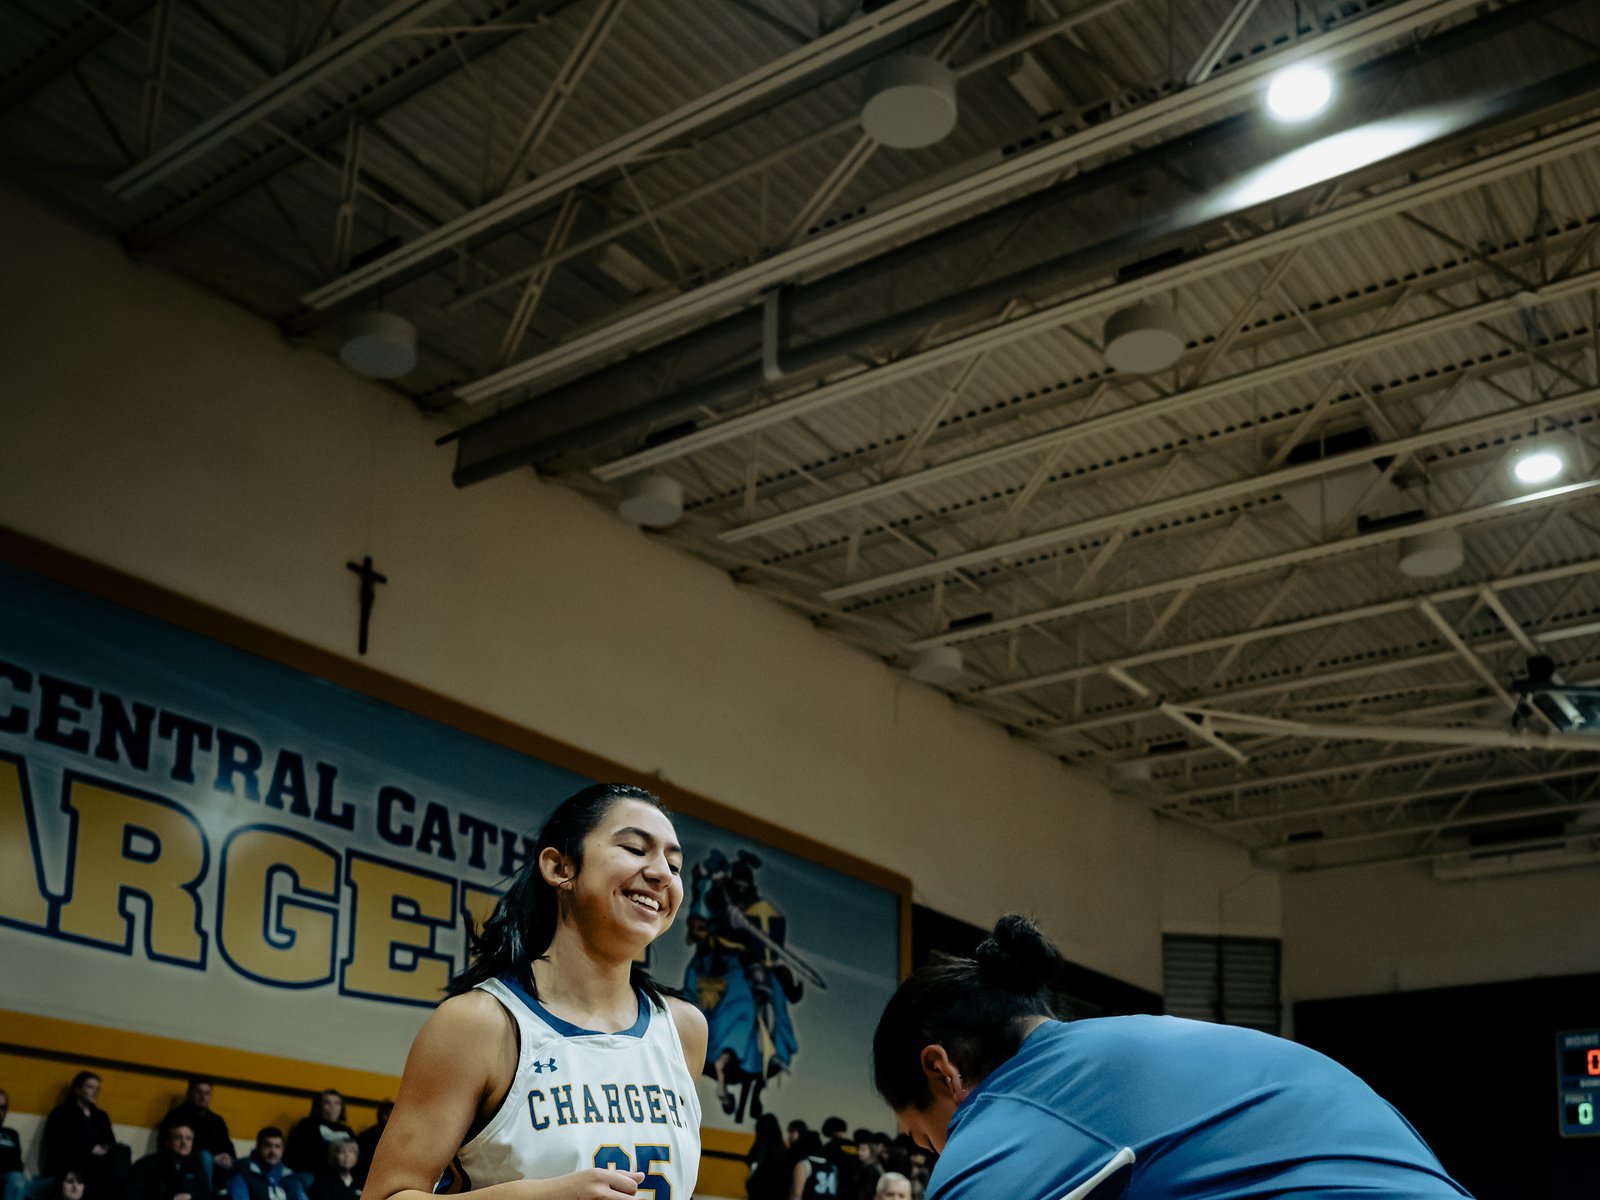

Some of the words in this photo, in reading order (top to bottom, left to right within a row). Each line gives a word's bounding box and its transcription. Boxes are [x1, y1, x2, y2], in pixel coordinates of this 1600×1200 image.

[0, 660, 356, 831] CENTRAL
[0, 749, 513, 1010] RGE
[527, 1083, 689, 1131] CHARGER
[1578, 1102, 1594, 1126] 0
